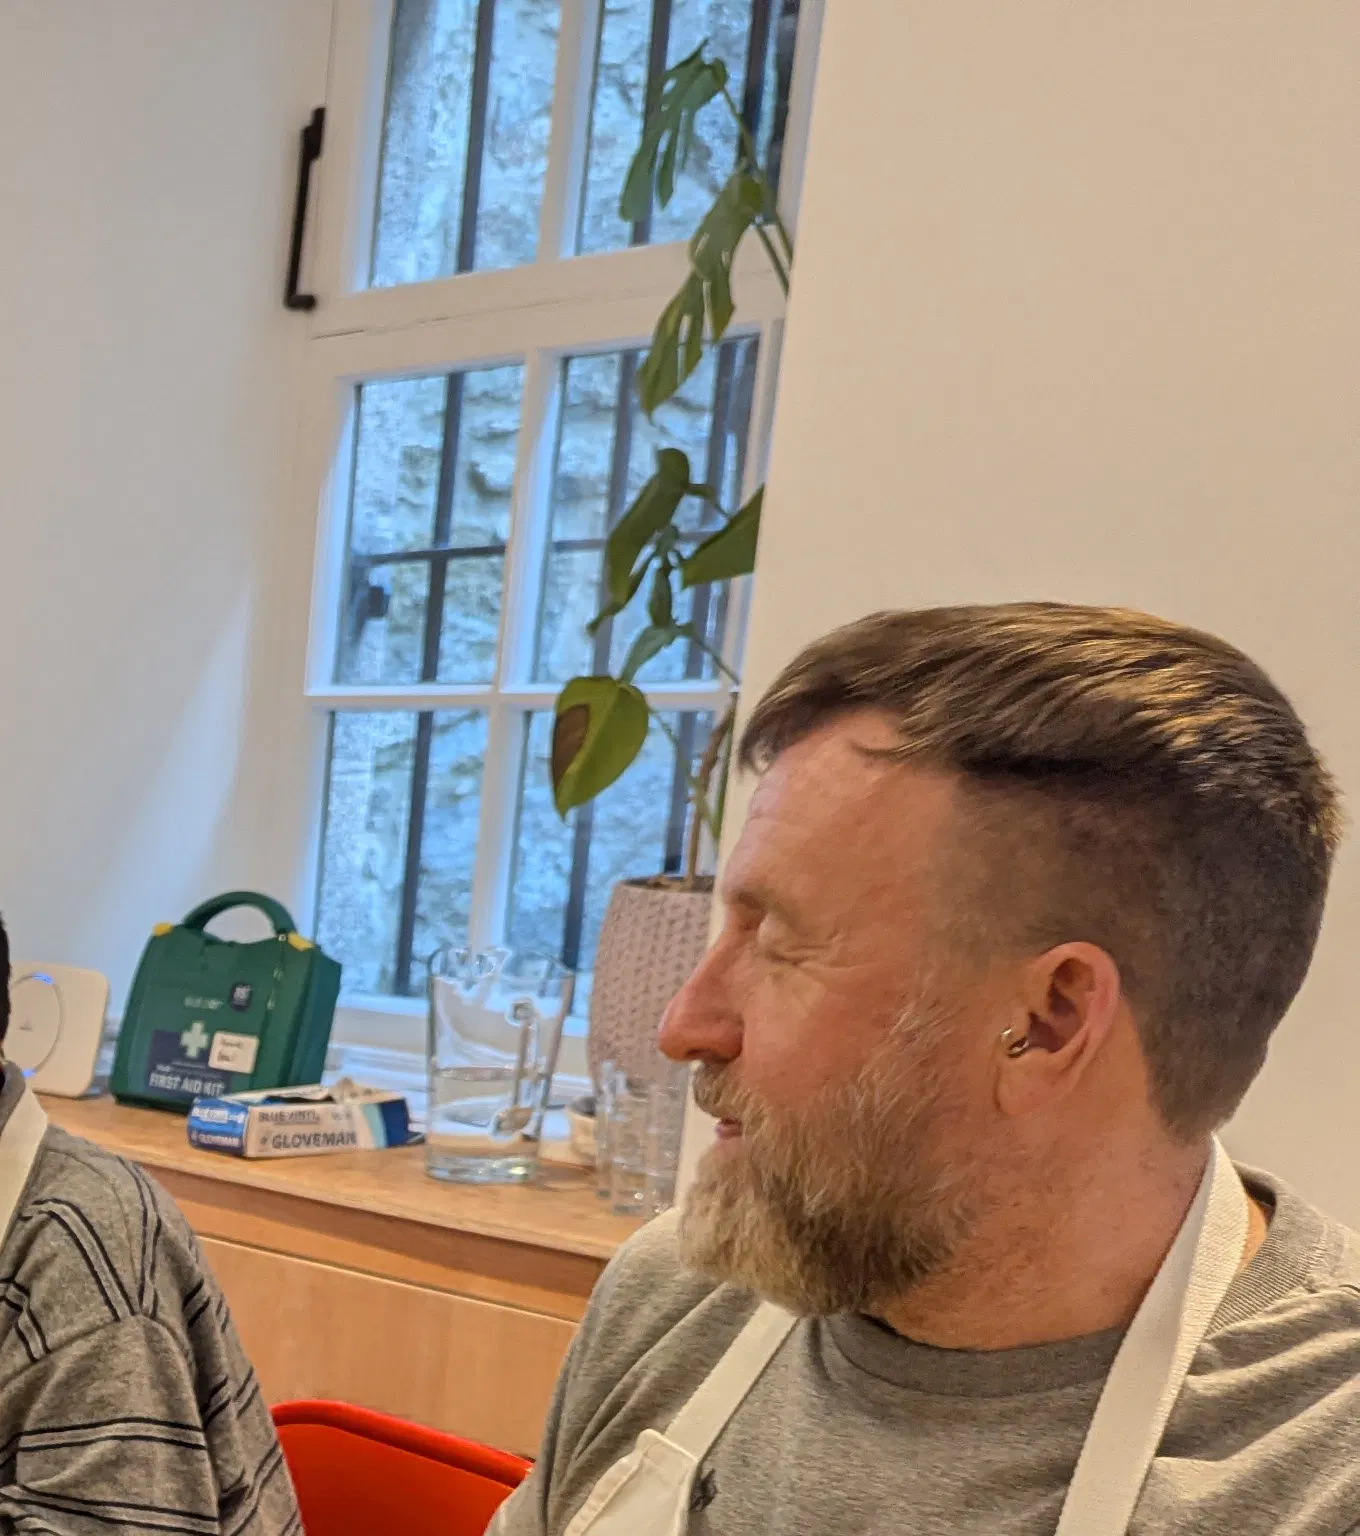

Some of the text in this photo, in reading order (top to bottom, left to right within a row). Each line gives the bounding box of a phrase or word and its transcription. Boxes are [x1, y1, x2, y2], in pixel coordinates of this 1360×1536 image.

[149, 1071, 182, 1091] FIRST
[181, 1077, 204, 1095] AID
[271, 1131, 357, 1149] GLOVEMAN
